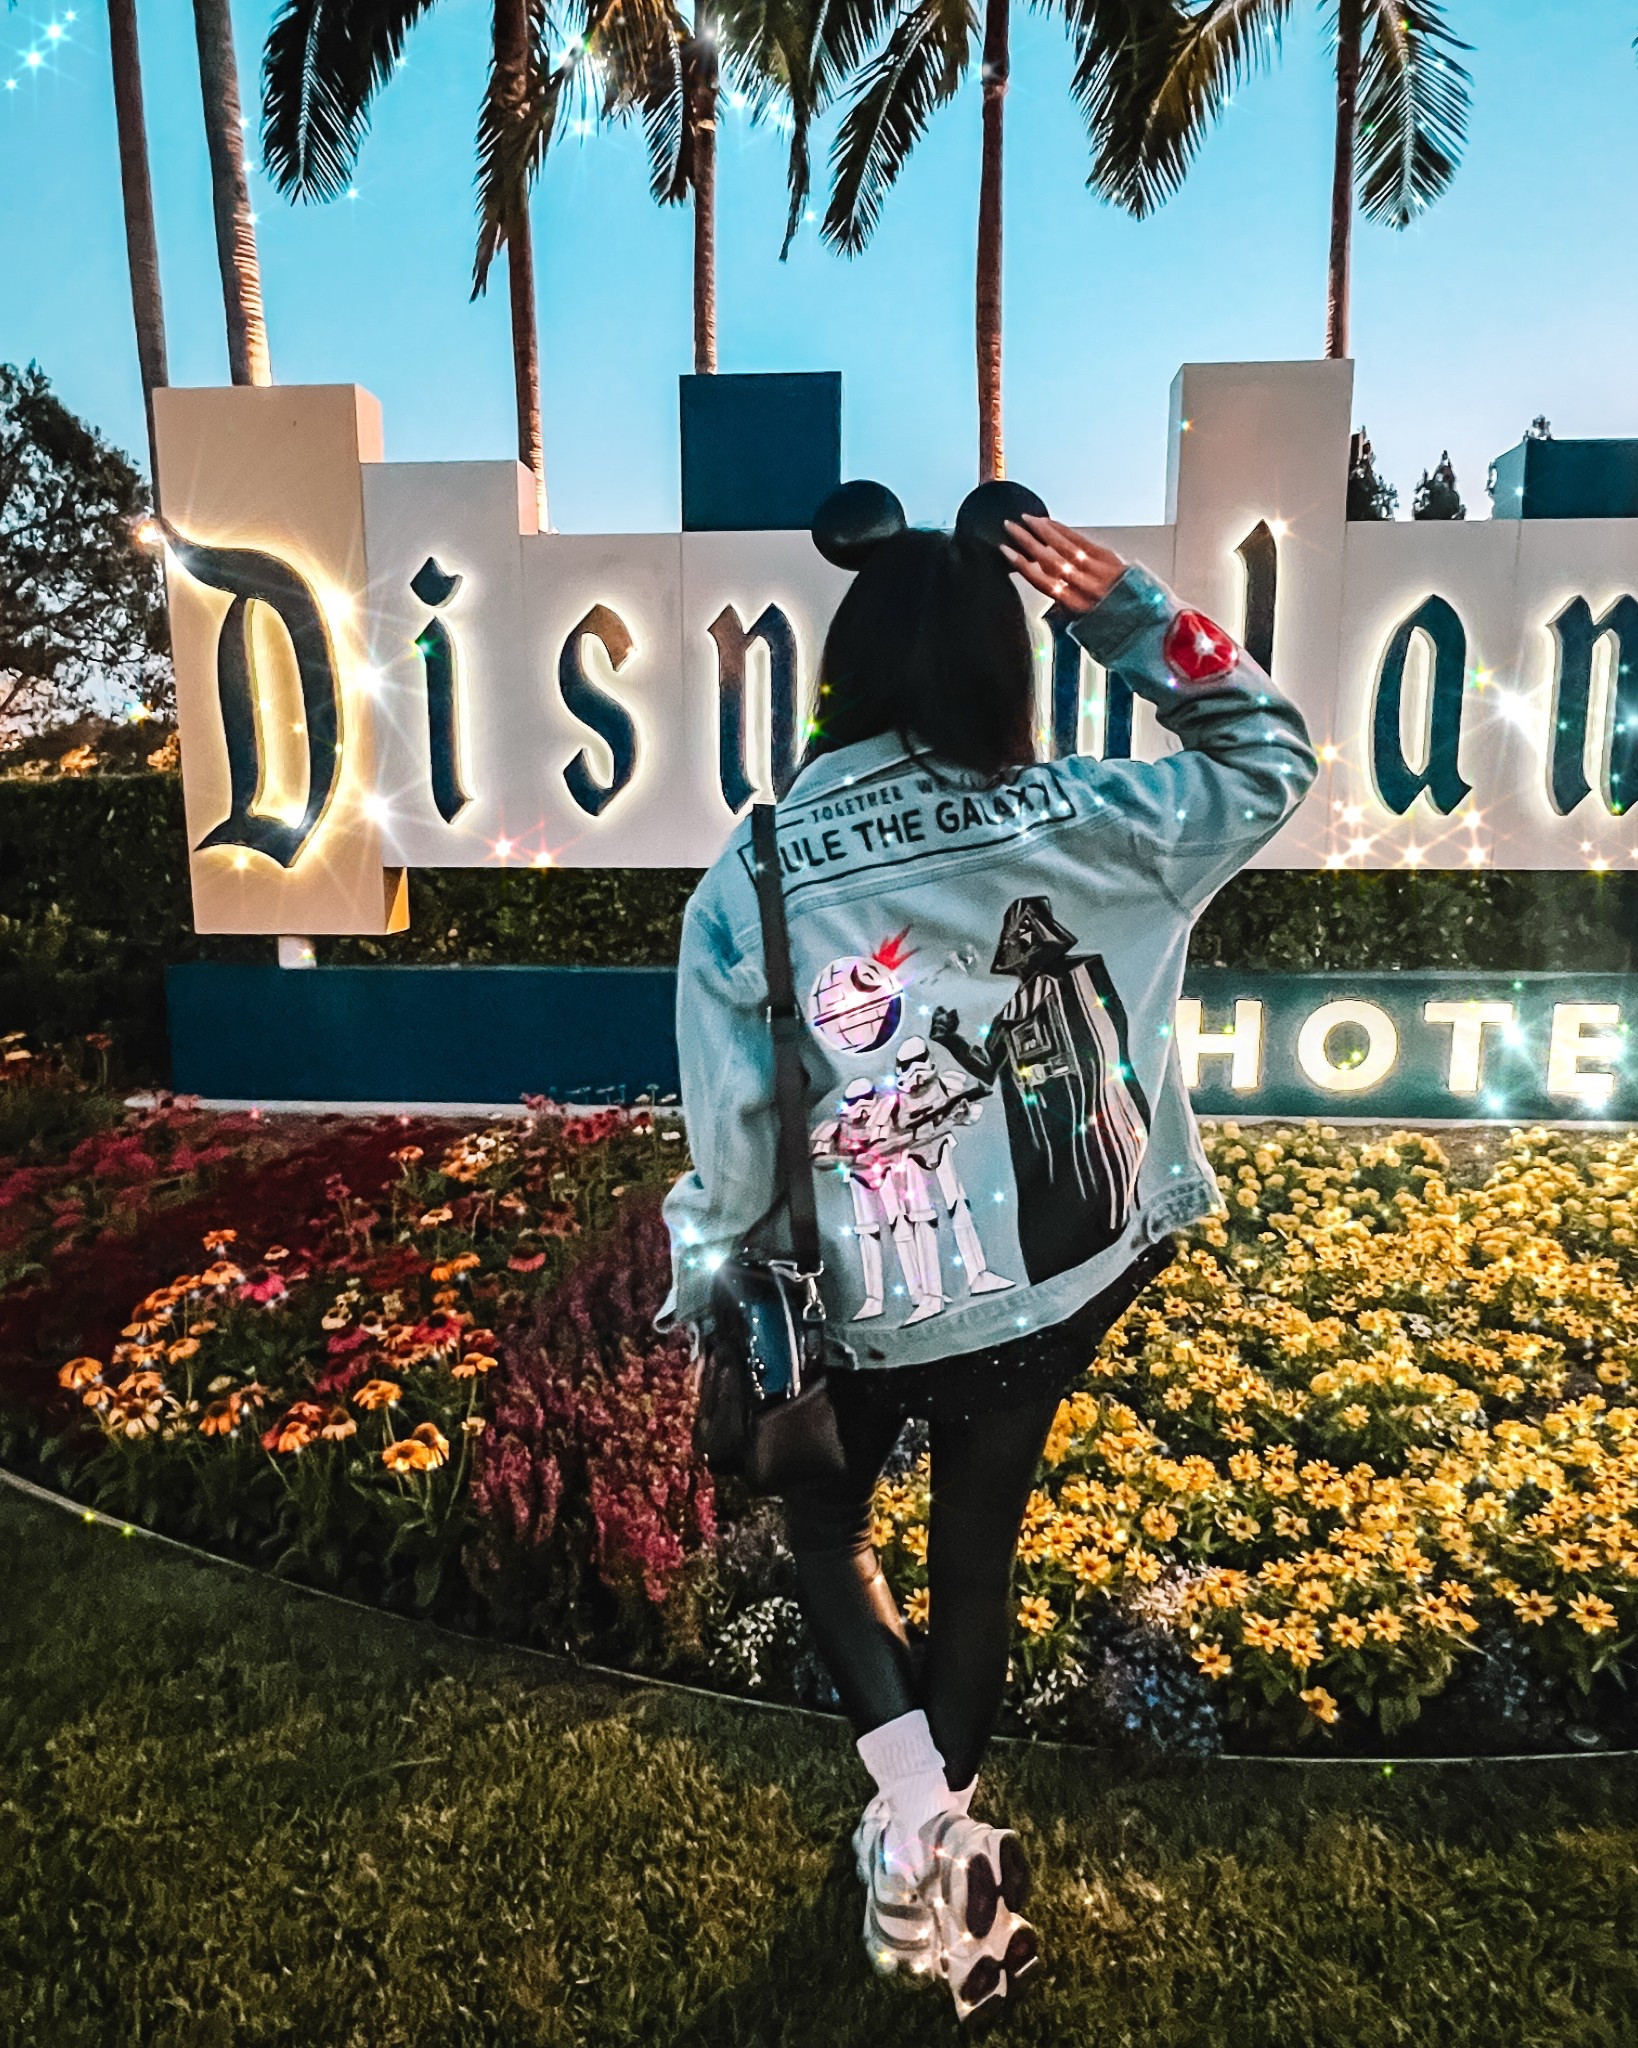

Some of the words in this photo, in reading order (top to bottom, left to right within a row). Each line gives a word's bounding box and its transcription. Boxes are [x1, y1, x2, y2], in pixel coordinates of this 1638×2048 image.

[778, 829, 848, 878] ULE
[851, 808, 925, 852] THE
[935, 780, 1051, 834] GALAXY
[811, 785, 903, 823] TOGETHER
